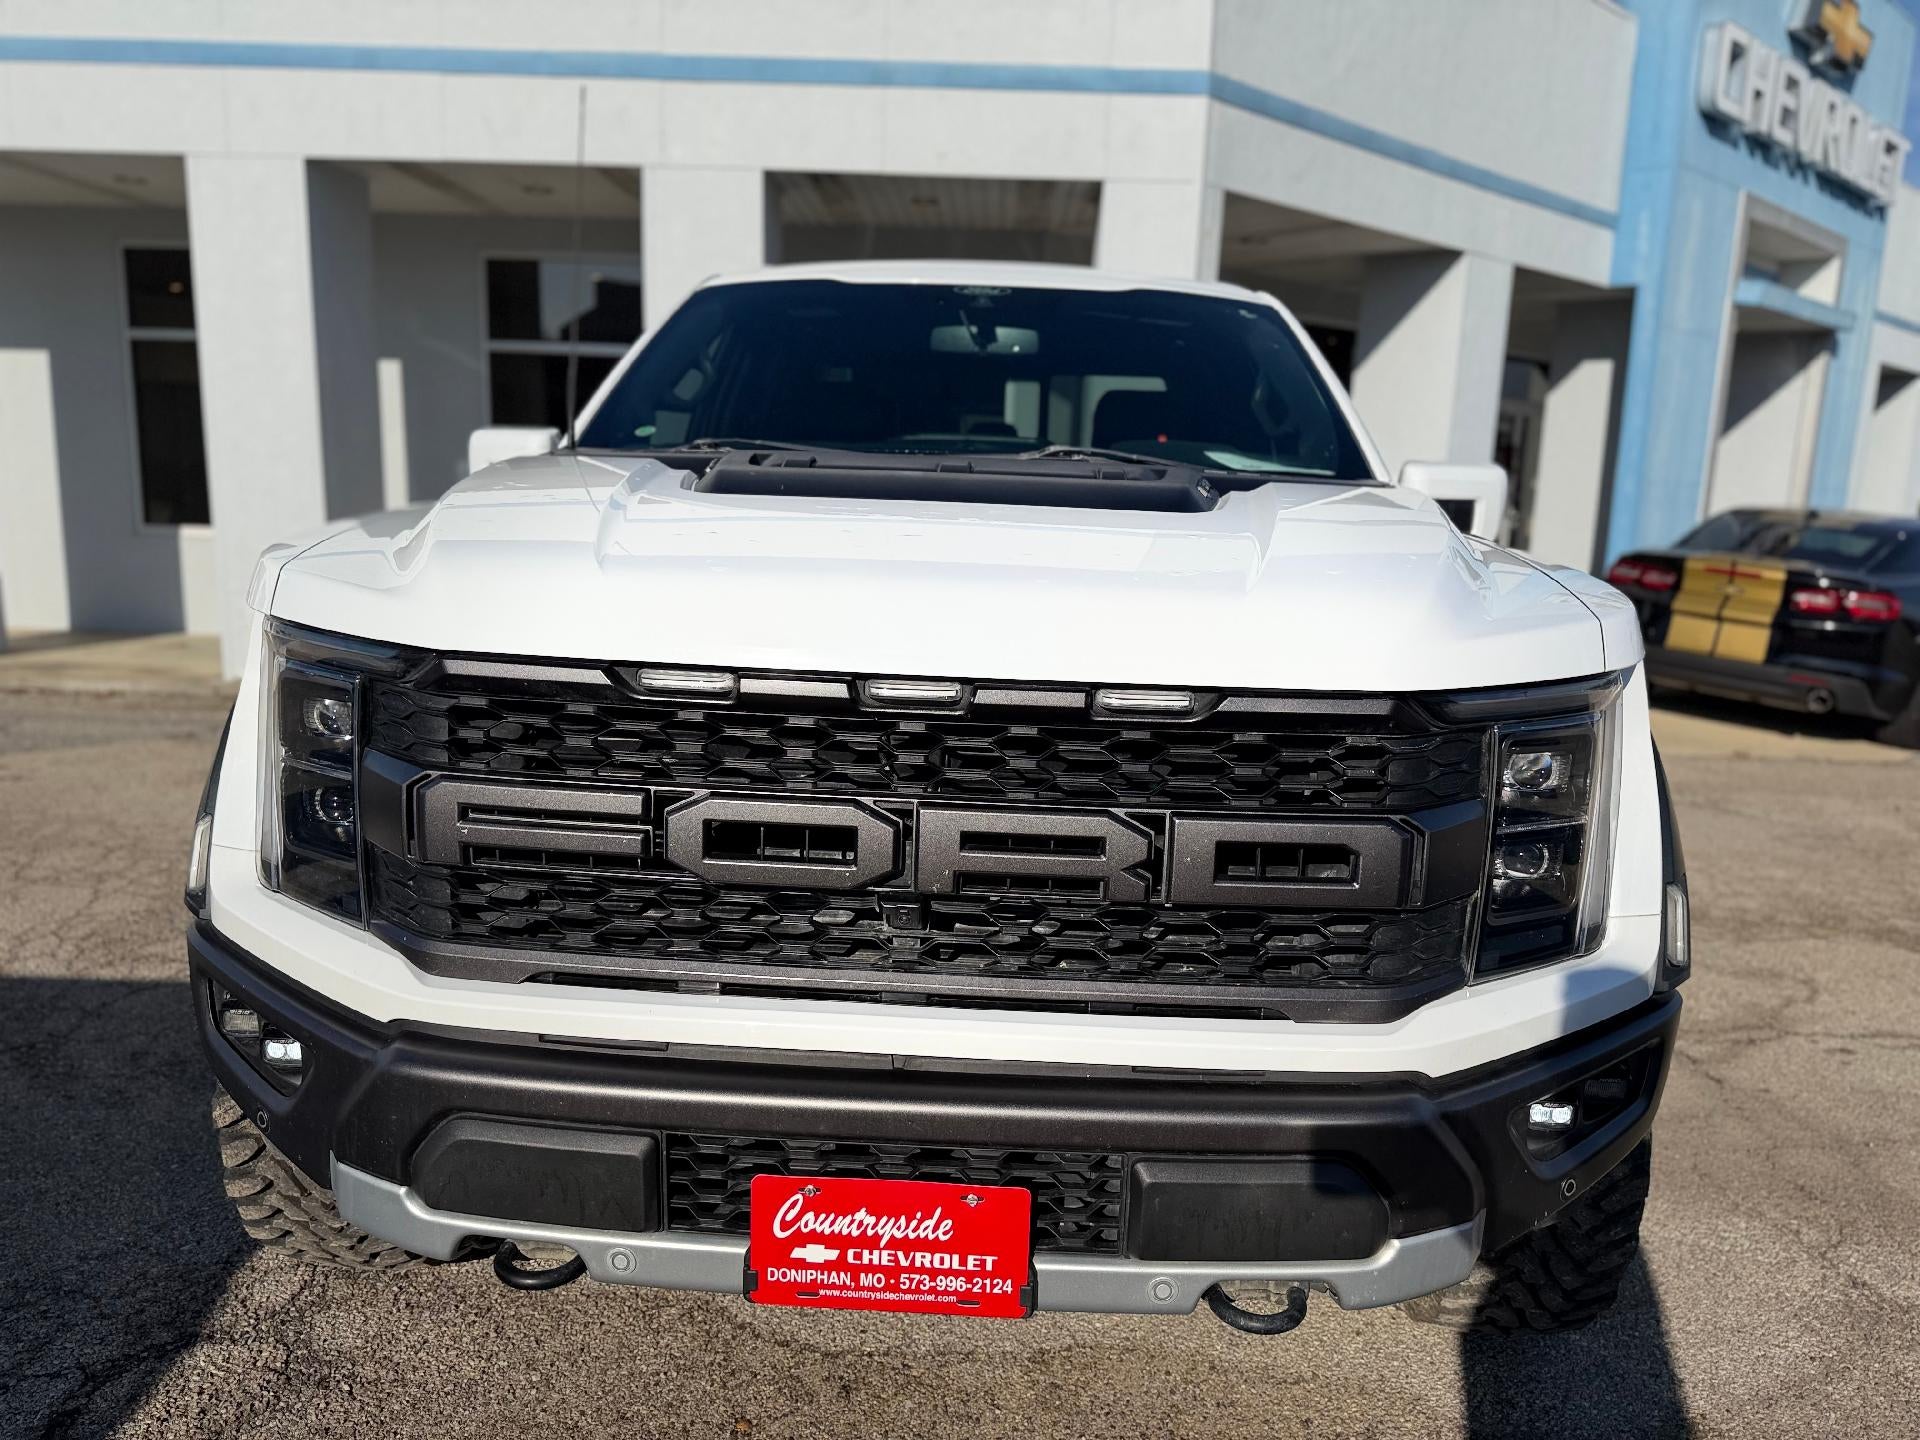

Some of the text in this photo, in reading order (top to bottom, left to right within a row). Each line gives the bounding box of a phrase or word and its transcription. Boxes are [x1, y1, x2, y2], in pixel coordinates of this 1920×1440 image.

[415, 776, 1411, 907] FORD
[772, 1193, 954, 1248] Countryside
[846, 1248, 998, 1271] CHEVROLET
[766, 1267, 855, 1288] DONIPHAN,
[859, 1272, 886, 1288] MO
[899, 1273, 1013, 1294] 573-996-2124
[818, 1287, 957, 1303] www.countrysidechevrolet.com
